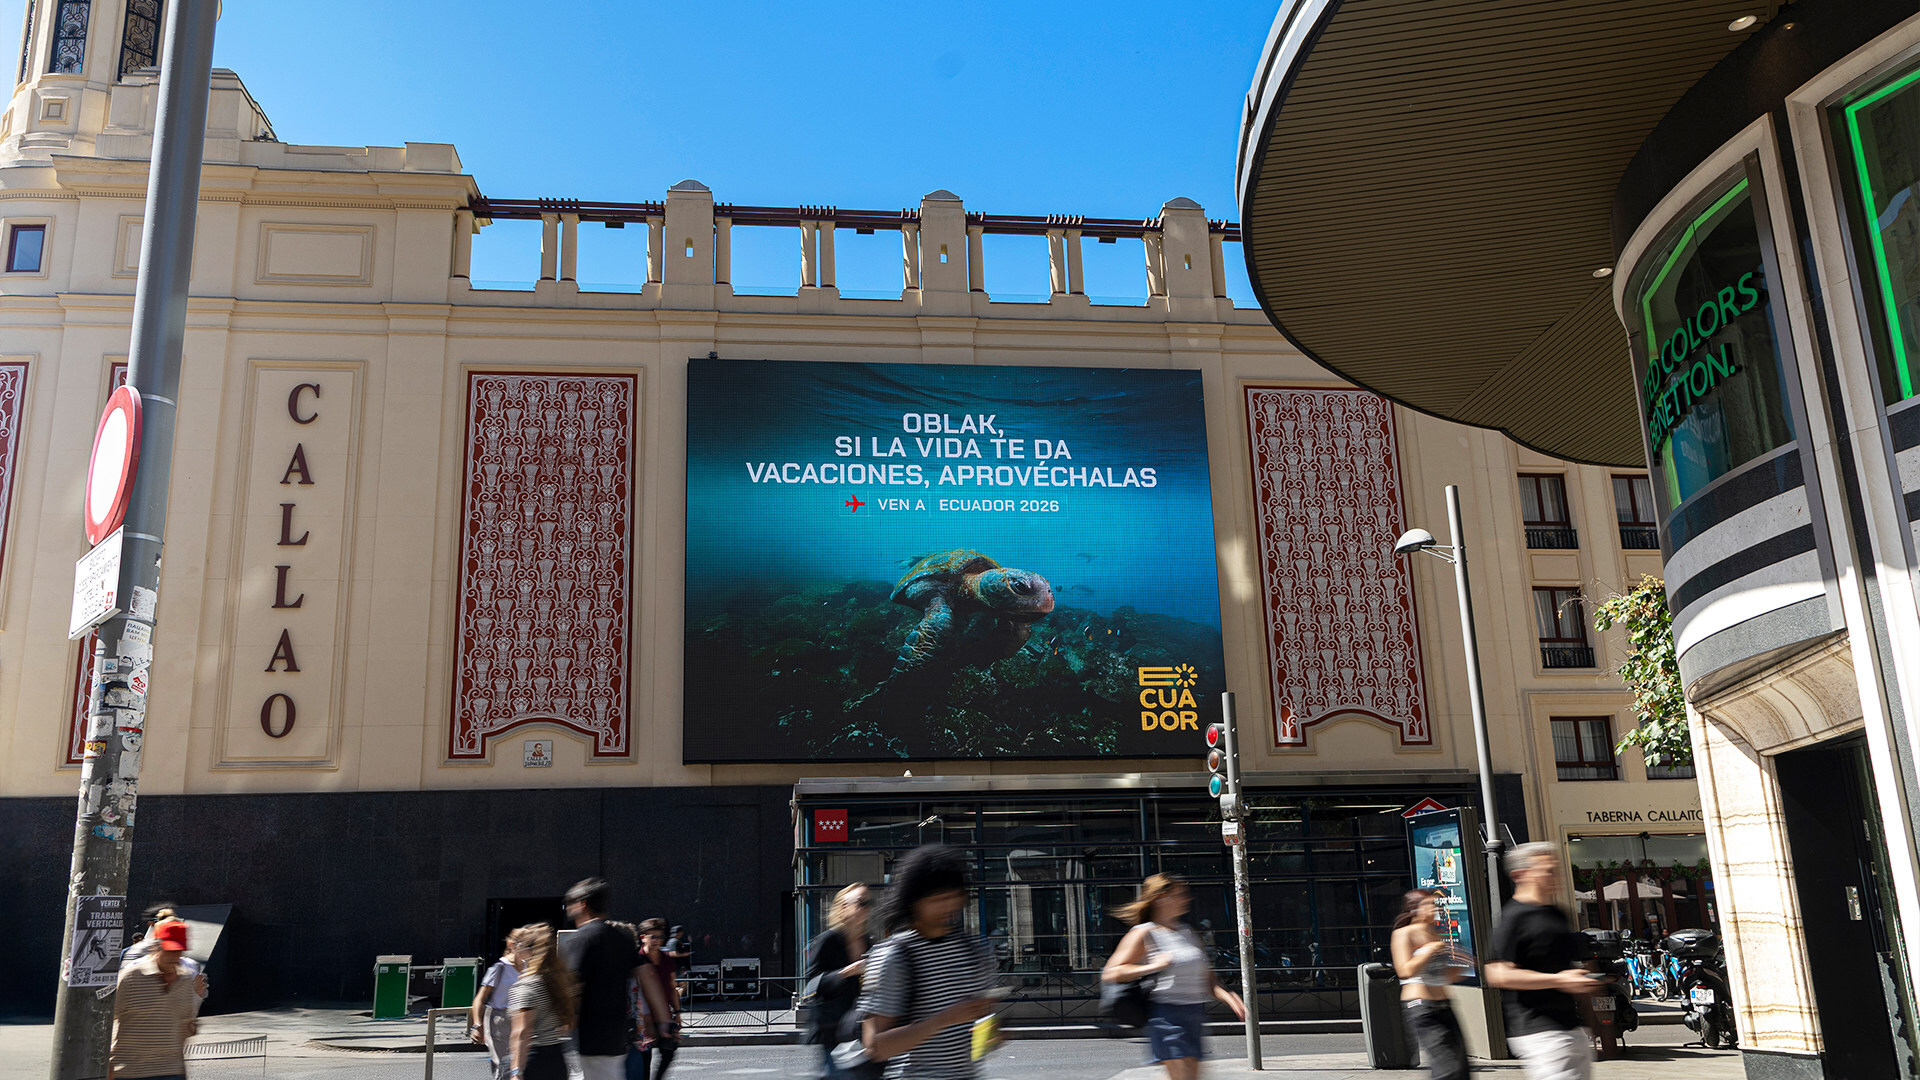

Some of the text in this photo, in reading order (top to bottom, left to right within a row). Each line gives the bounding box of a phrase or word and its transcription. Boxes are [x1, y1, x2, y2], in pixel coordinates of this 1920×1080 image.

[1660, 271, 1759, 374] COLORS
[1649, 343, 1736, 452] BENETTON.
[903, 412, 1004, 437] OBLAK,
[835, 436, 1072, 459] SI LA VIDA TE DA
[746, 460, 1157, 488] VACACIONES, APROVÉCHALAS
[877, 498, 1060, 512] VEN A ECUADOR 2026
[260, 383, 321, 739] CALLAO
[1139, 688, 1198, 709] CUA
[1141, 710, 1199, 731] DOR
[1586, 811, 1642, 822] TABERNA
[91, 912, 123, 920] TRABAJOS
